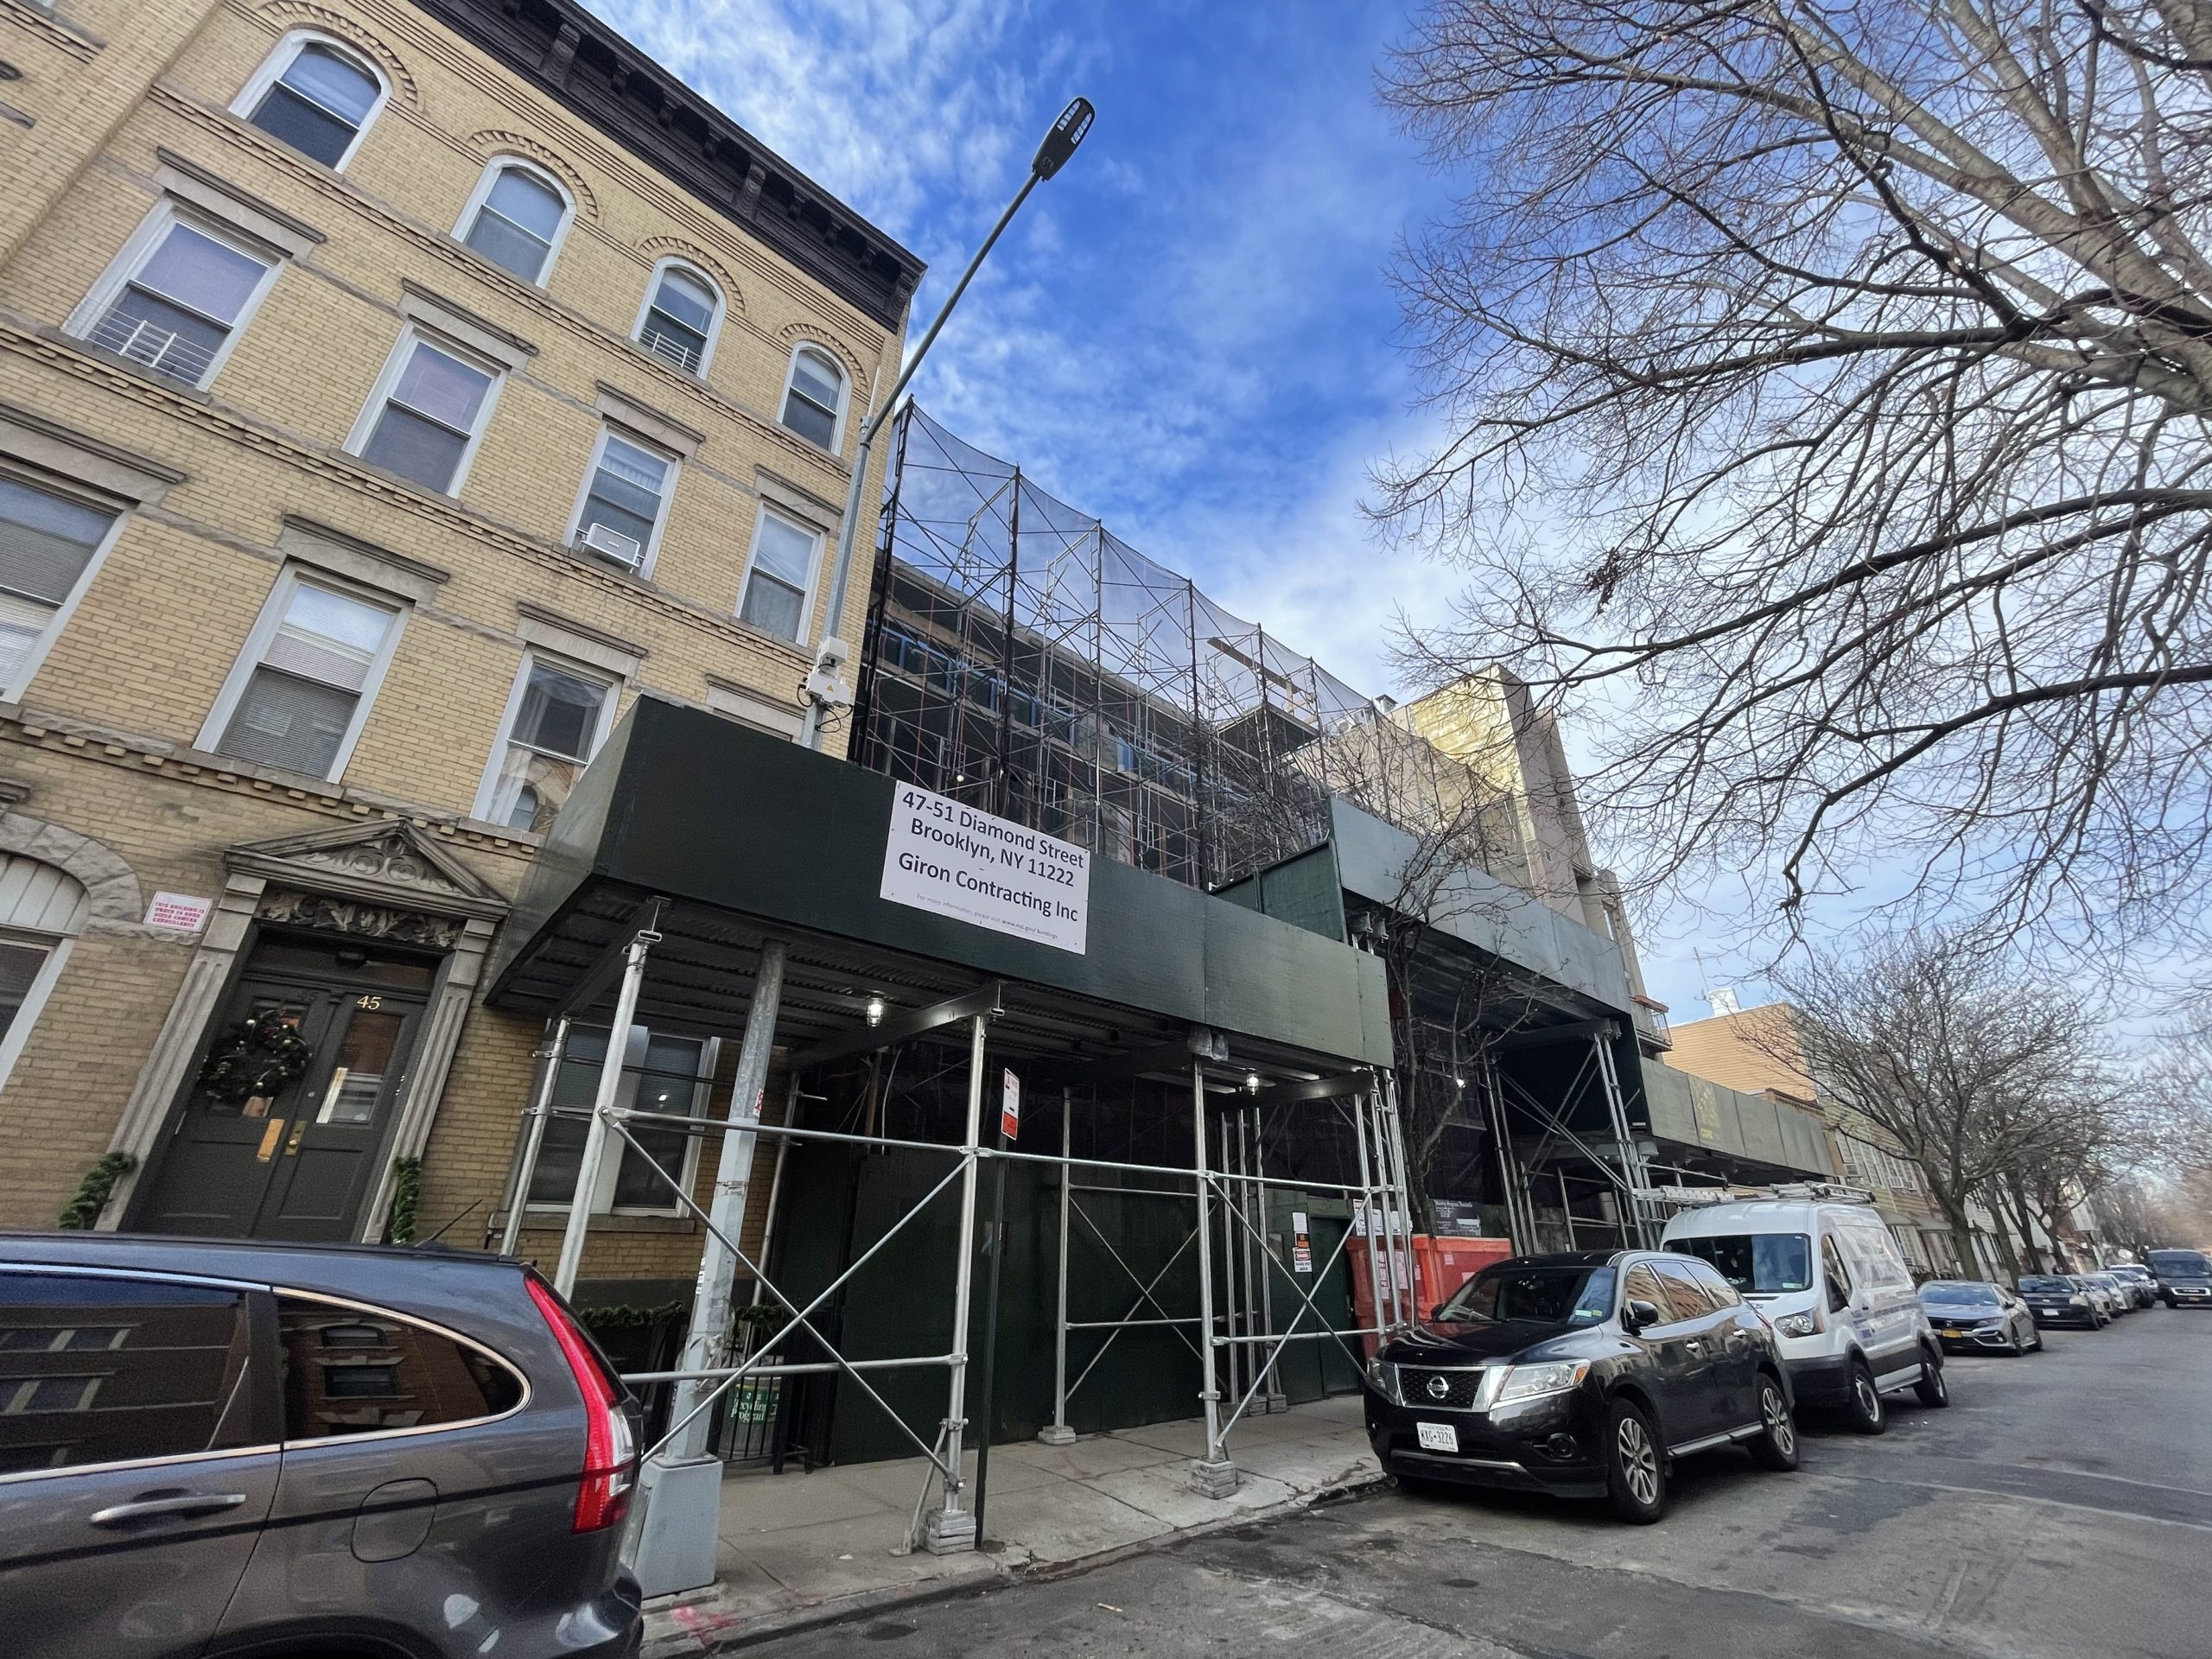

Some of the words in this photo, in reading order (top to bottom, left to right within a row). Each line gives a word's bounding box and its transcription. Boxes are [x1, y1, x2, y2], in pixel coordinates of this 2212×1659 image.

[903, 791, 953, 822] 47-51
[960, 811, 1034, 850] Diamond
[1039, 840, 1084, 868] Street
[912, 818, 995, 863] Brooklyn,
[1001, 849, 1024, 868] NY
[1028, 859, 1074, 887] 11222
[899, 853, 950, 882] Giron
[957, 871, 1051, 918] Contracting
[1057, 901, 1077, 921] Inc
[357, 995, 382, 1010] 45
